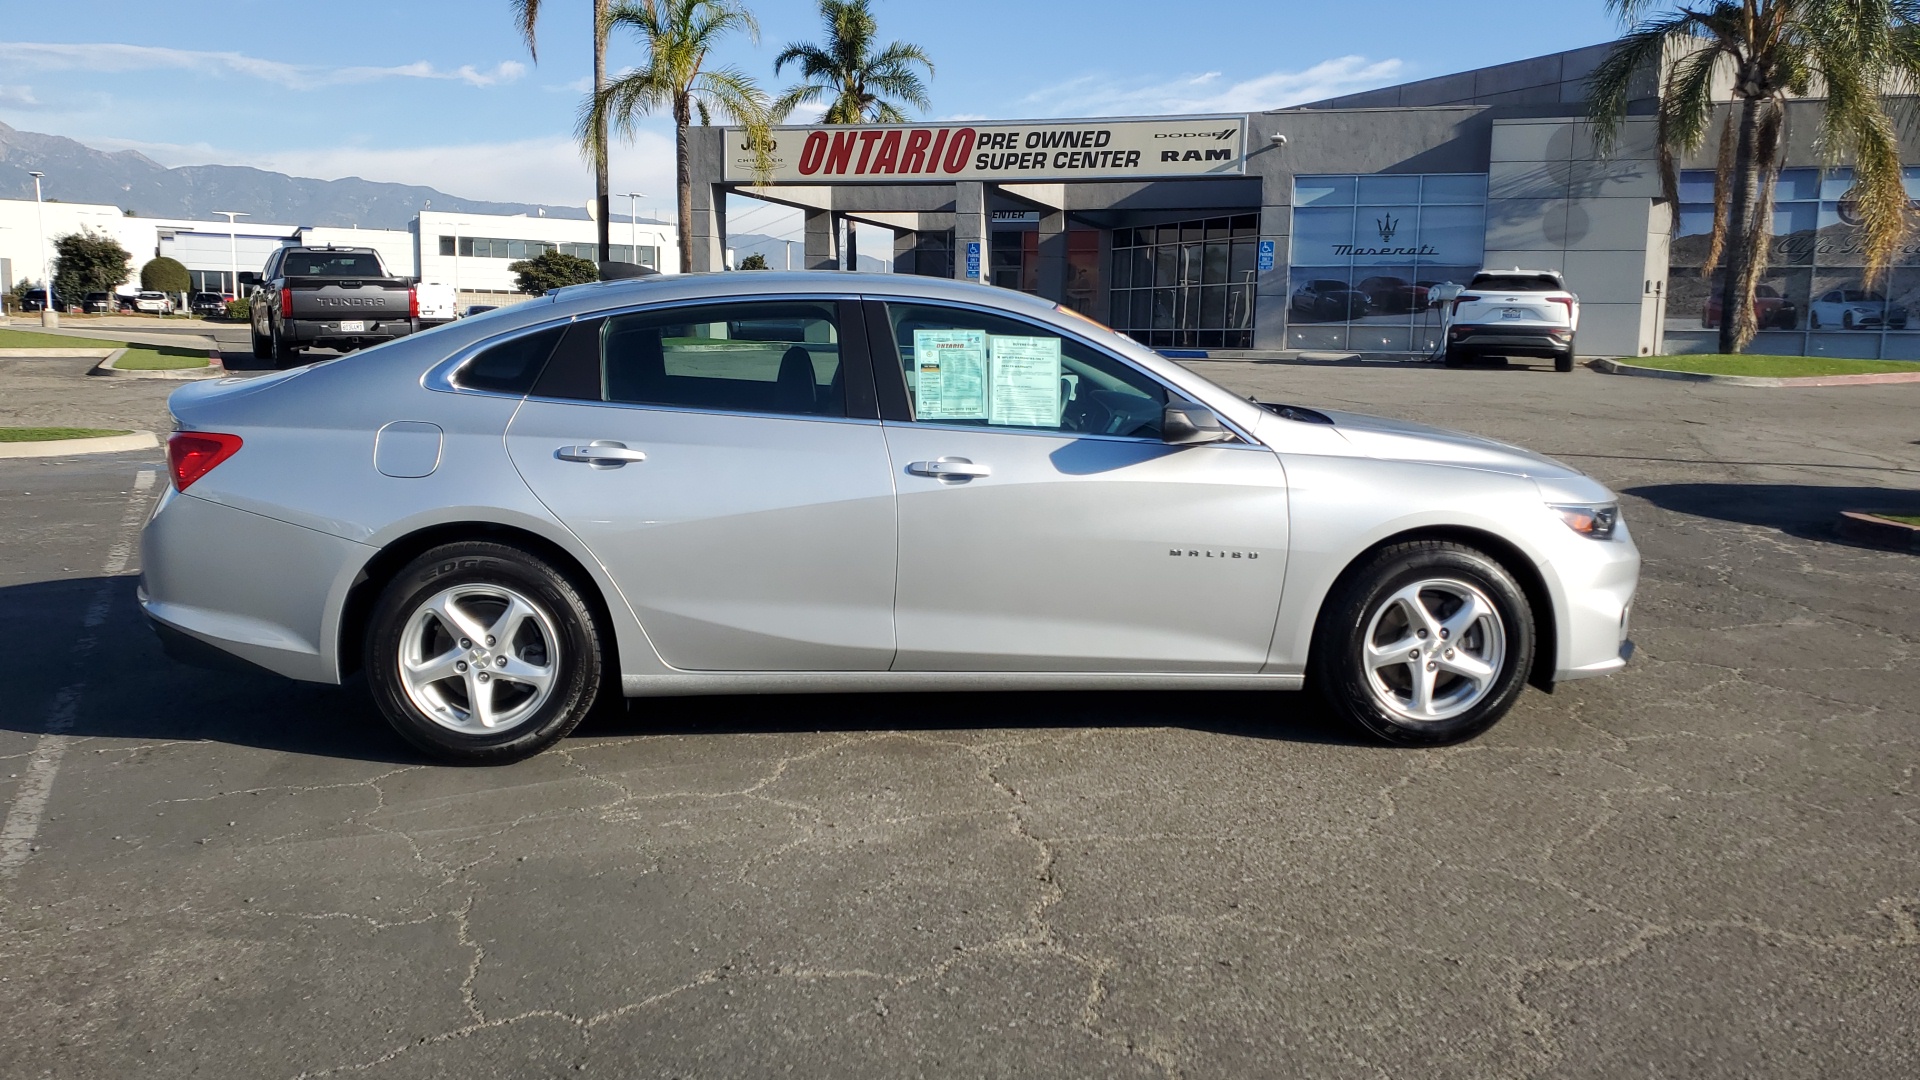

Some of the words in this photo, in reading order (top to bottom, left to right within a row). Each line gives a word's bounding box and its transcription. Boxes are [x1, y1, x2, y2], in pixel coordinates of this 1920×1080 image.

[977, 132, 1020, 150] PRE
[1025, 130, 1111, 149] OWNED
[1154, 131, 1224, 139] DODGE
[798, 128, 976, 175] ONTARIO
[1161, 149, 1231, 162] RAM
[975, 152, 1047, 170] SUPER
[1052, 150, 1141, 169] CENTER
[1332, 244, 1440, 256] Maserati
[1777, 235, 1834, 263] Alfa
[316, 297, 386, 307] TUNDRA
[1169, 548, 1260, 560] MALIBU
[419, 558, 500, 582] EDGE
